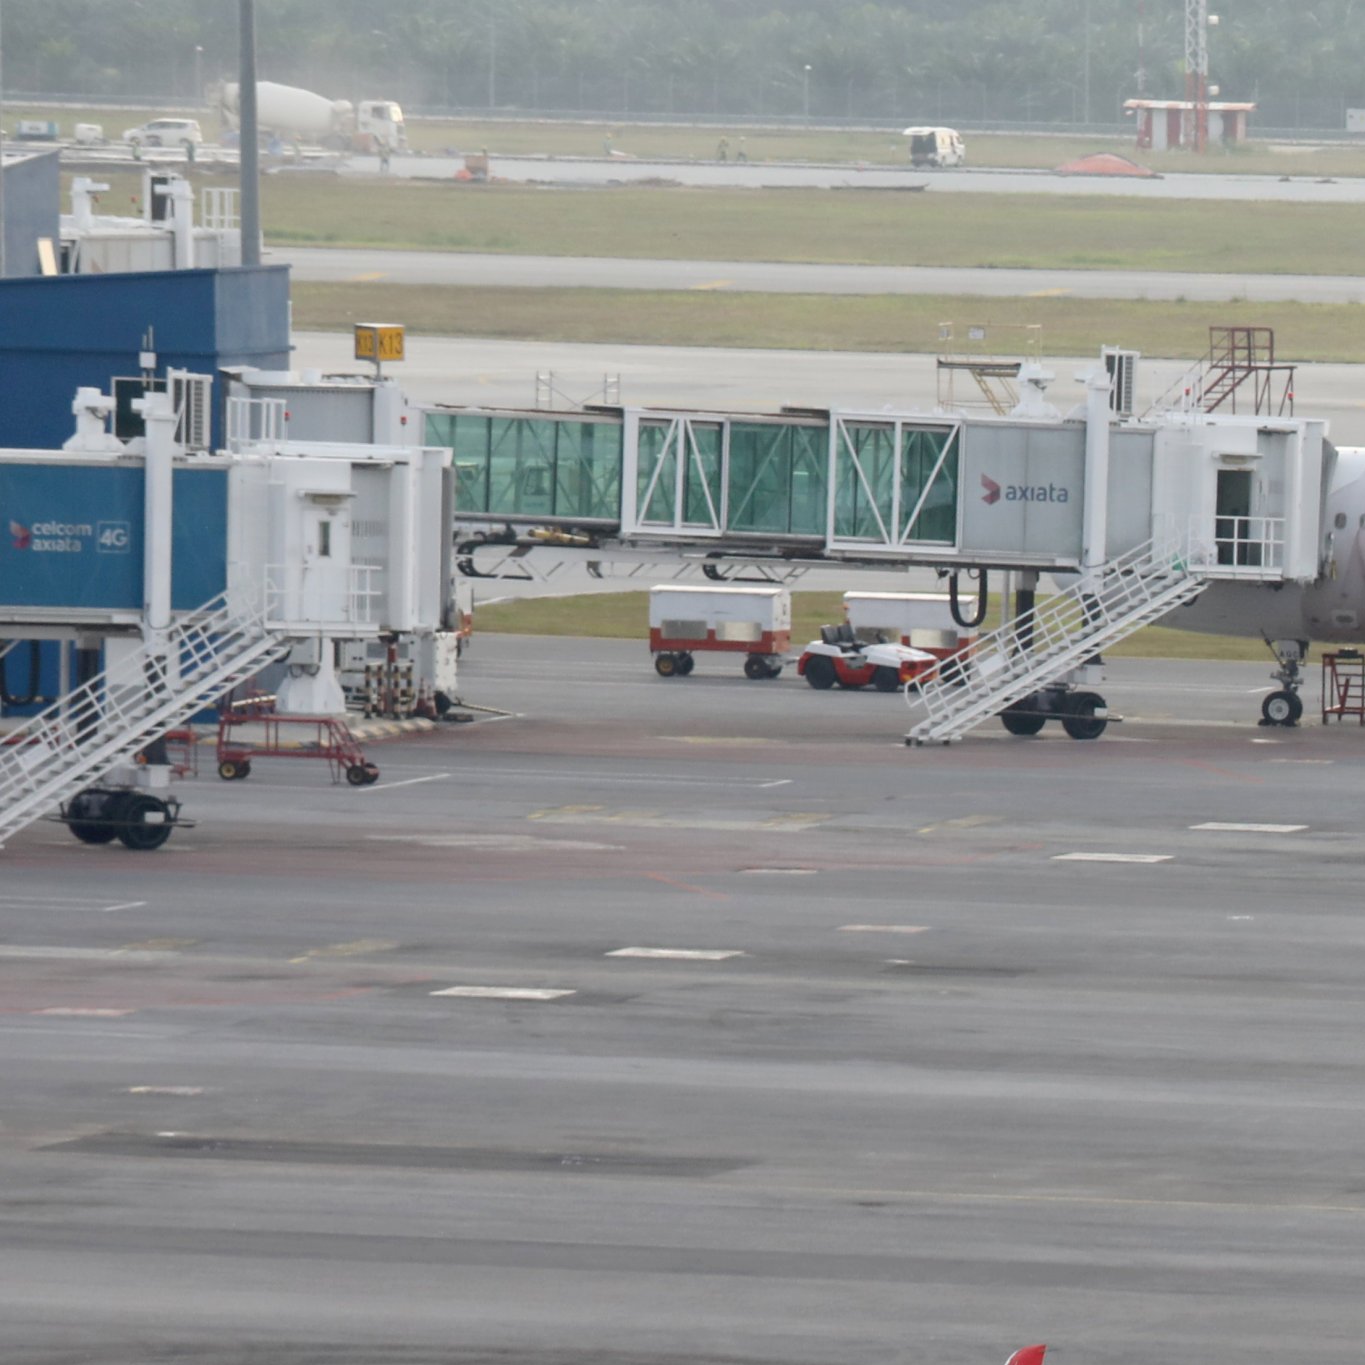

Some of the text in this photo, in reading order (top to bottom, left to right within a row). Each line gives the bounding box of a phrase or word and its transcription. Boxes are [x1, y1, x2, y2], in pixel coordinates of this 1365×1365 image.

[378, 332, 402, 354] K13
[31, 521, 93, 536] celcom
[100, 528, 128, 546] 4G
